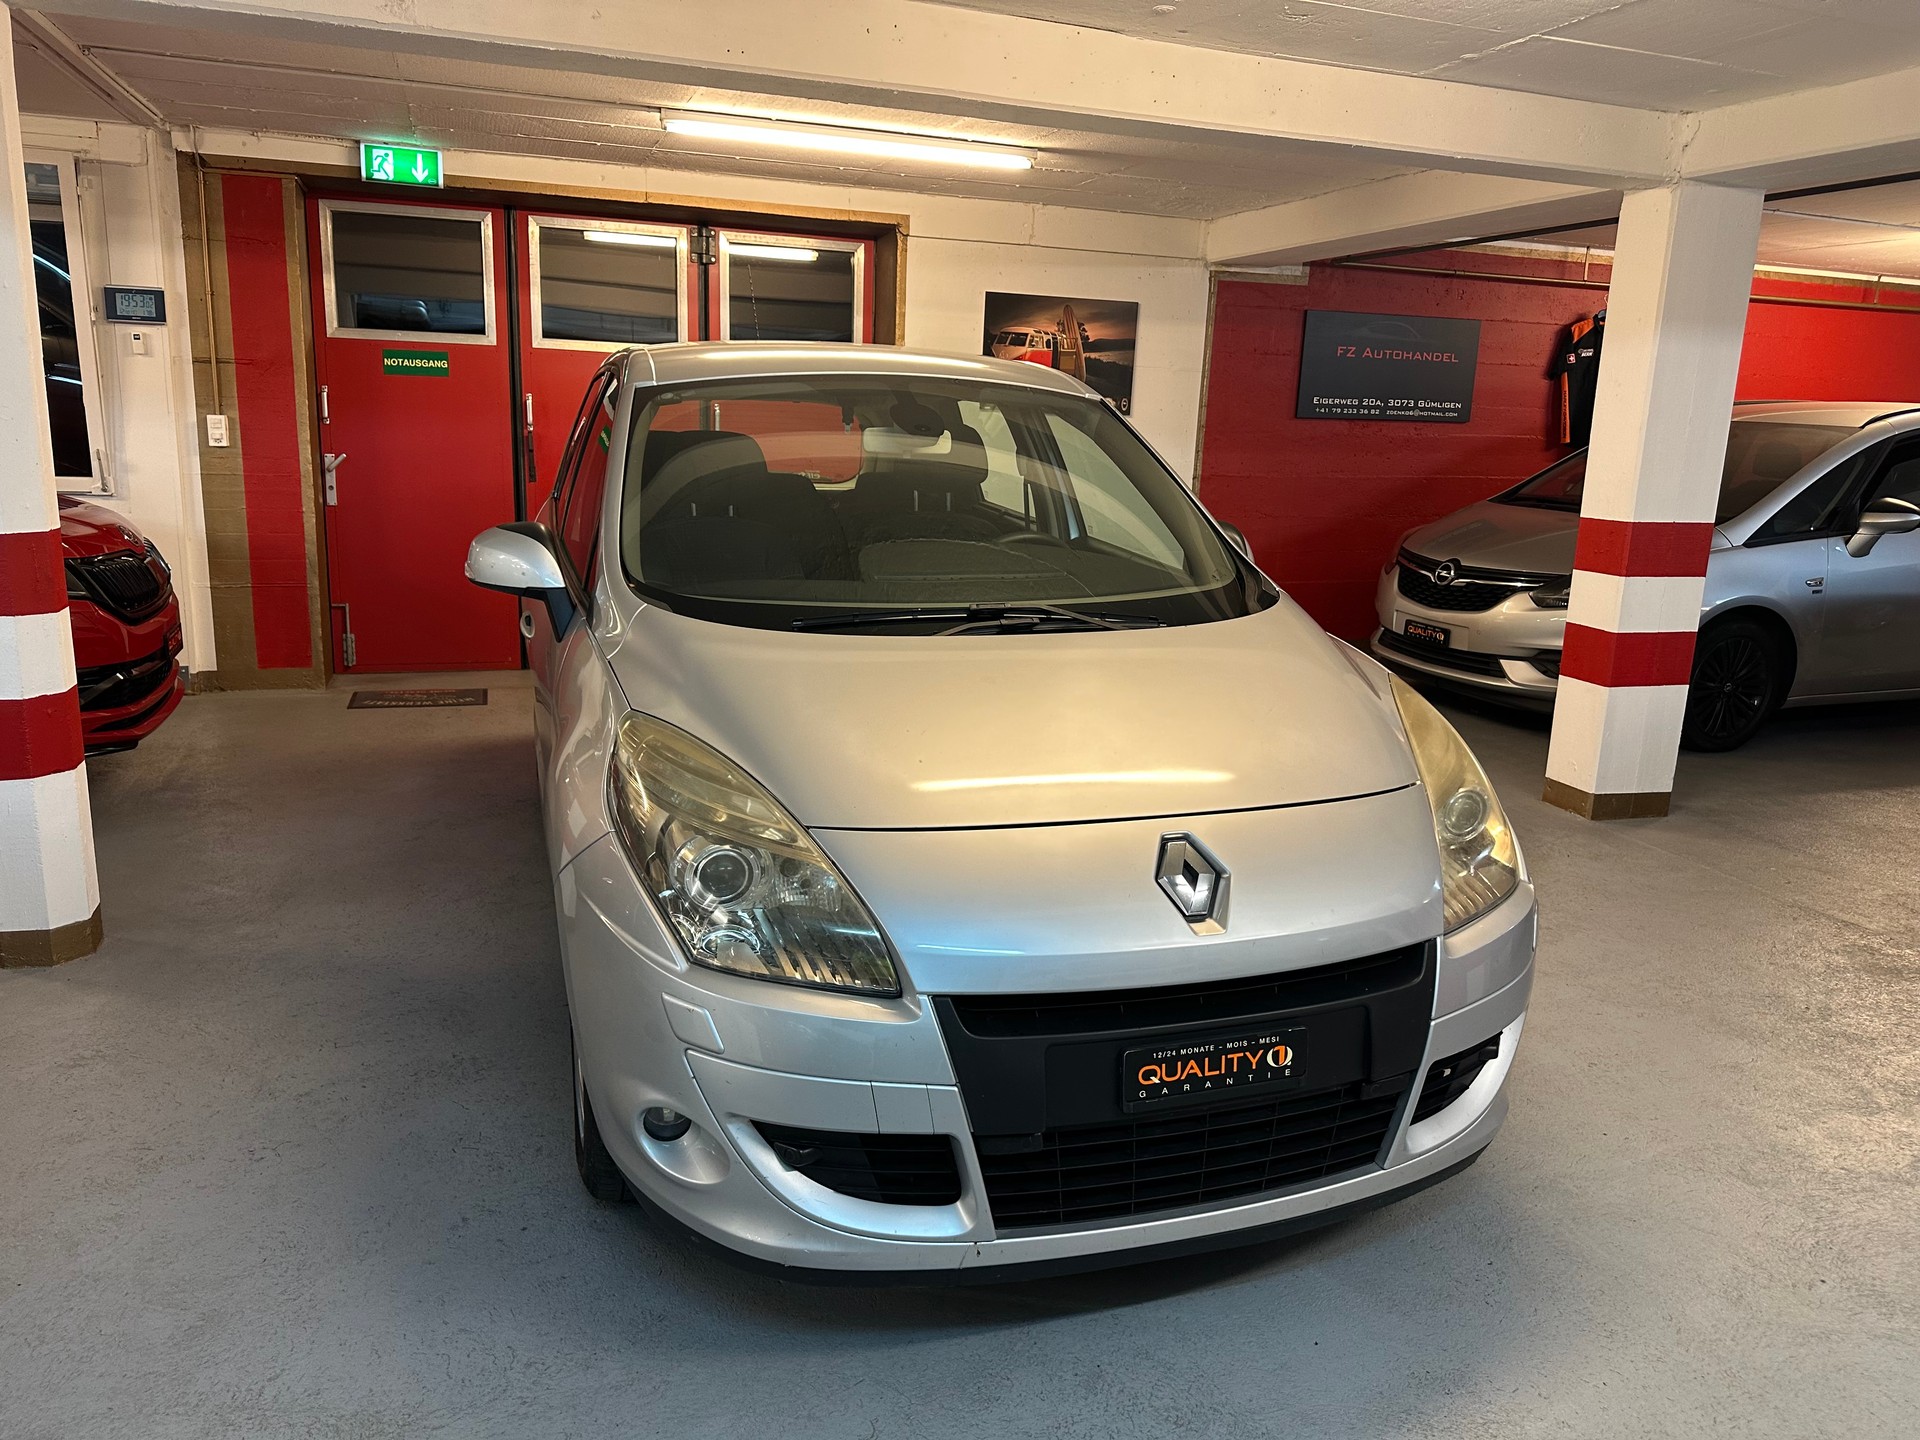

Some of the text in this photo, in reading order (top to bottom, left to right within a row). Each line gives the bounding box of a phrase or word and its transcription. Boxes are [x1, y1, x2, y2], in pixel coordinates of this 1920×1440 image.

[1337, 346, 1355, 357] FZ
[384, 358, 448, 368] NOTAUSGANG
[1388, 399, 1414, 407] 3073
[1408, 625, 1437, 638] QUALITY
[1153, 1050, 1177, 1059] 12/24
[1180, 1045, 1215, 1055] MONATE
[1226, 1040, 1248, 1048] MOIS
[1259, 1036, 1280, 1044] MESI
[1138, 1050, 1264, 1085] QUALITY
[1138, 1069, 1291, 1098] GARANTIE
